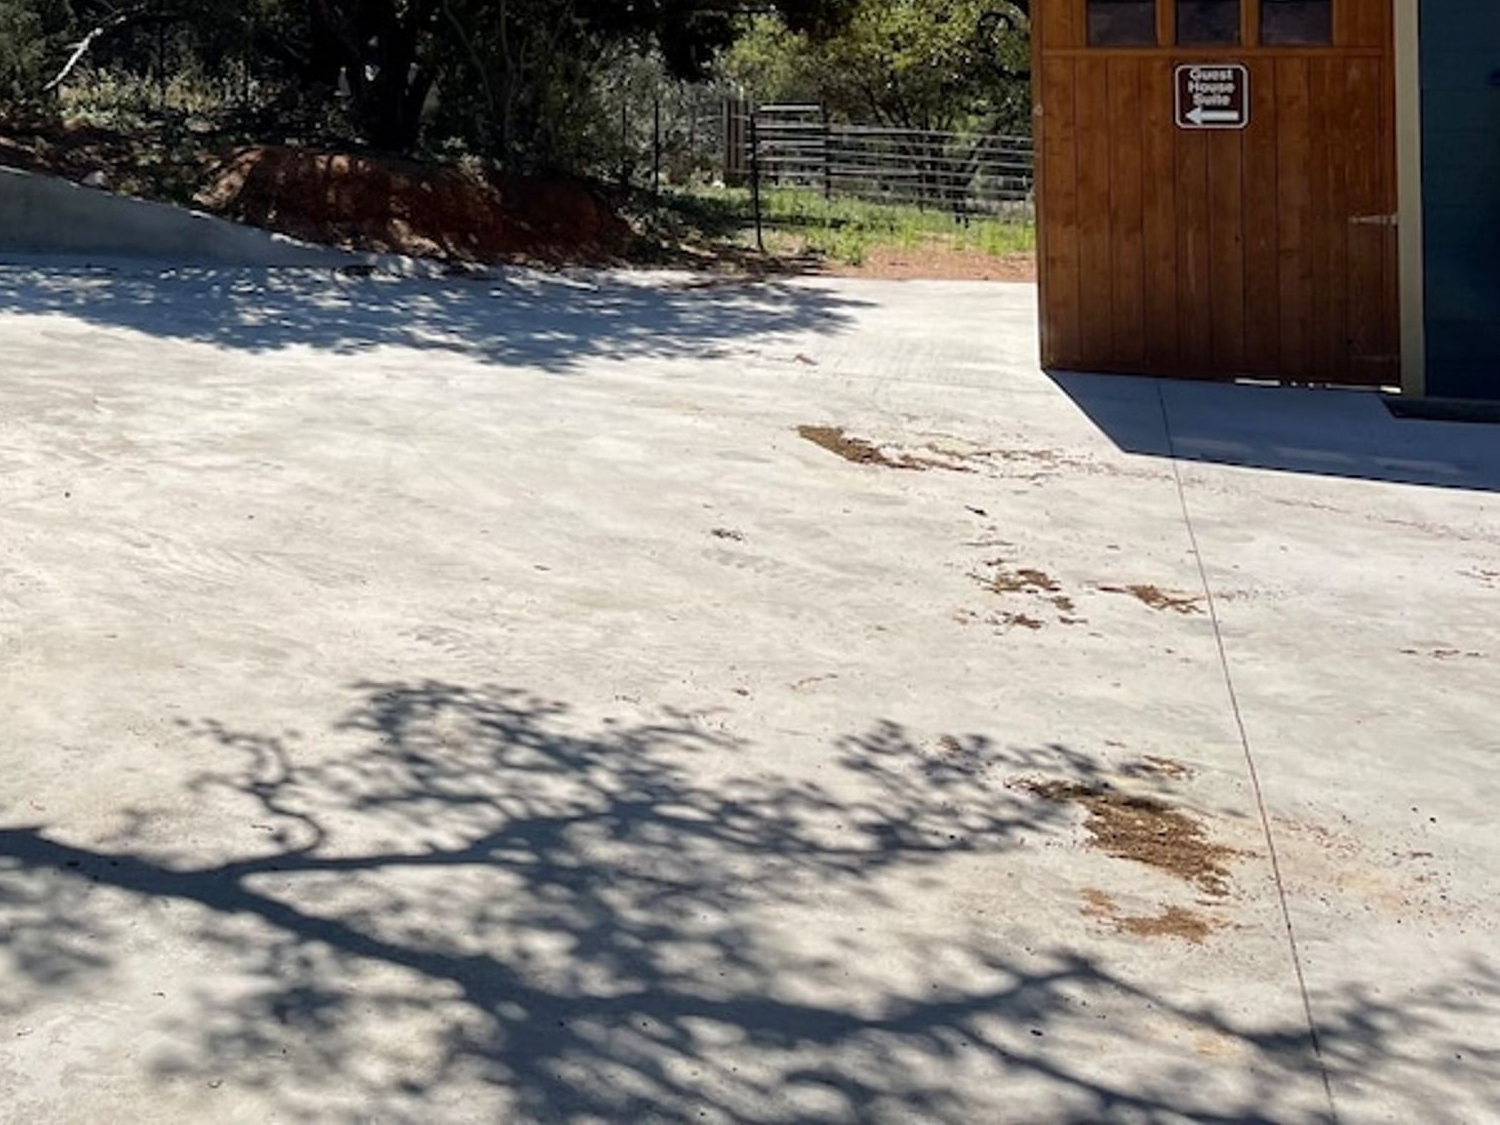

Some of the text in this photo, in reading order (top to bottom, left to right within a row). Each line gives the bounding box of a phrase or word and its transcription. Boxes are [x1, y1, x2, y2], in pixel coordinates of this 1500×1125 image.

[1189, 68, 1233, 81] Guest
[1187, 80, 1235, 93] House
[1192, 93, 1231, 106] Suite
